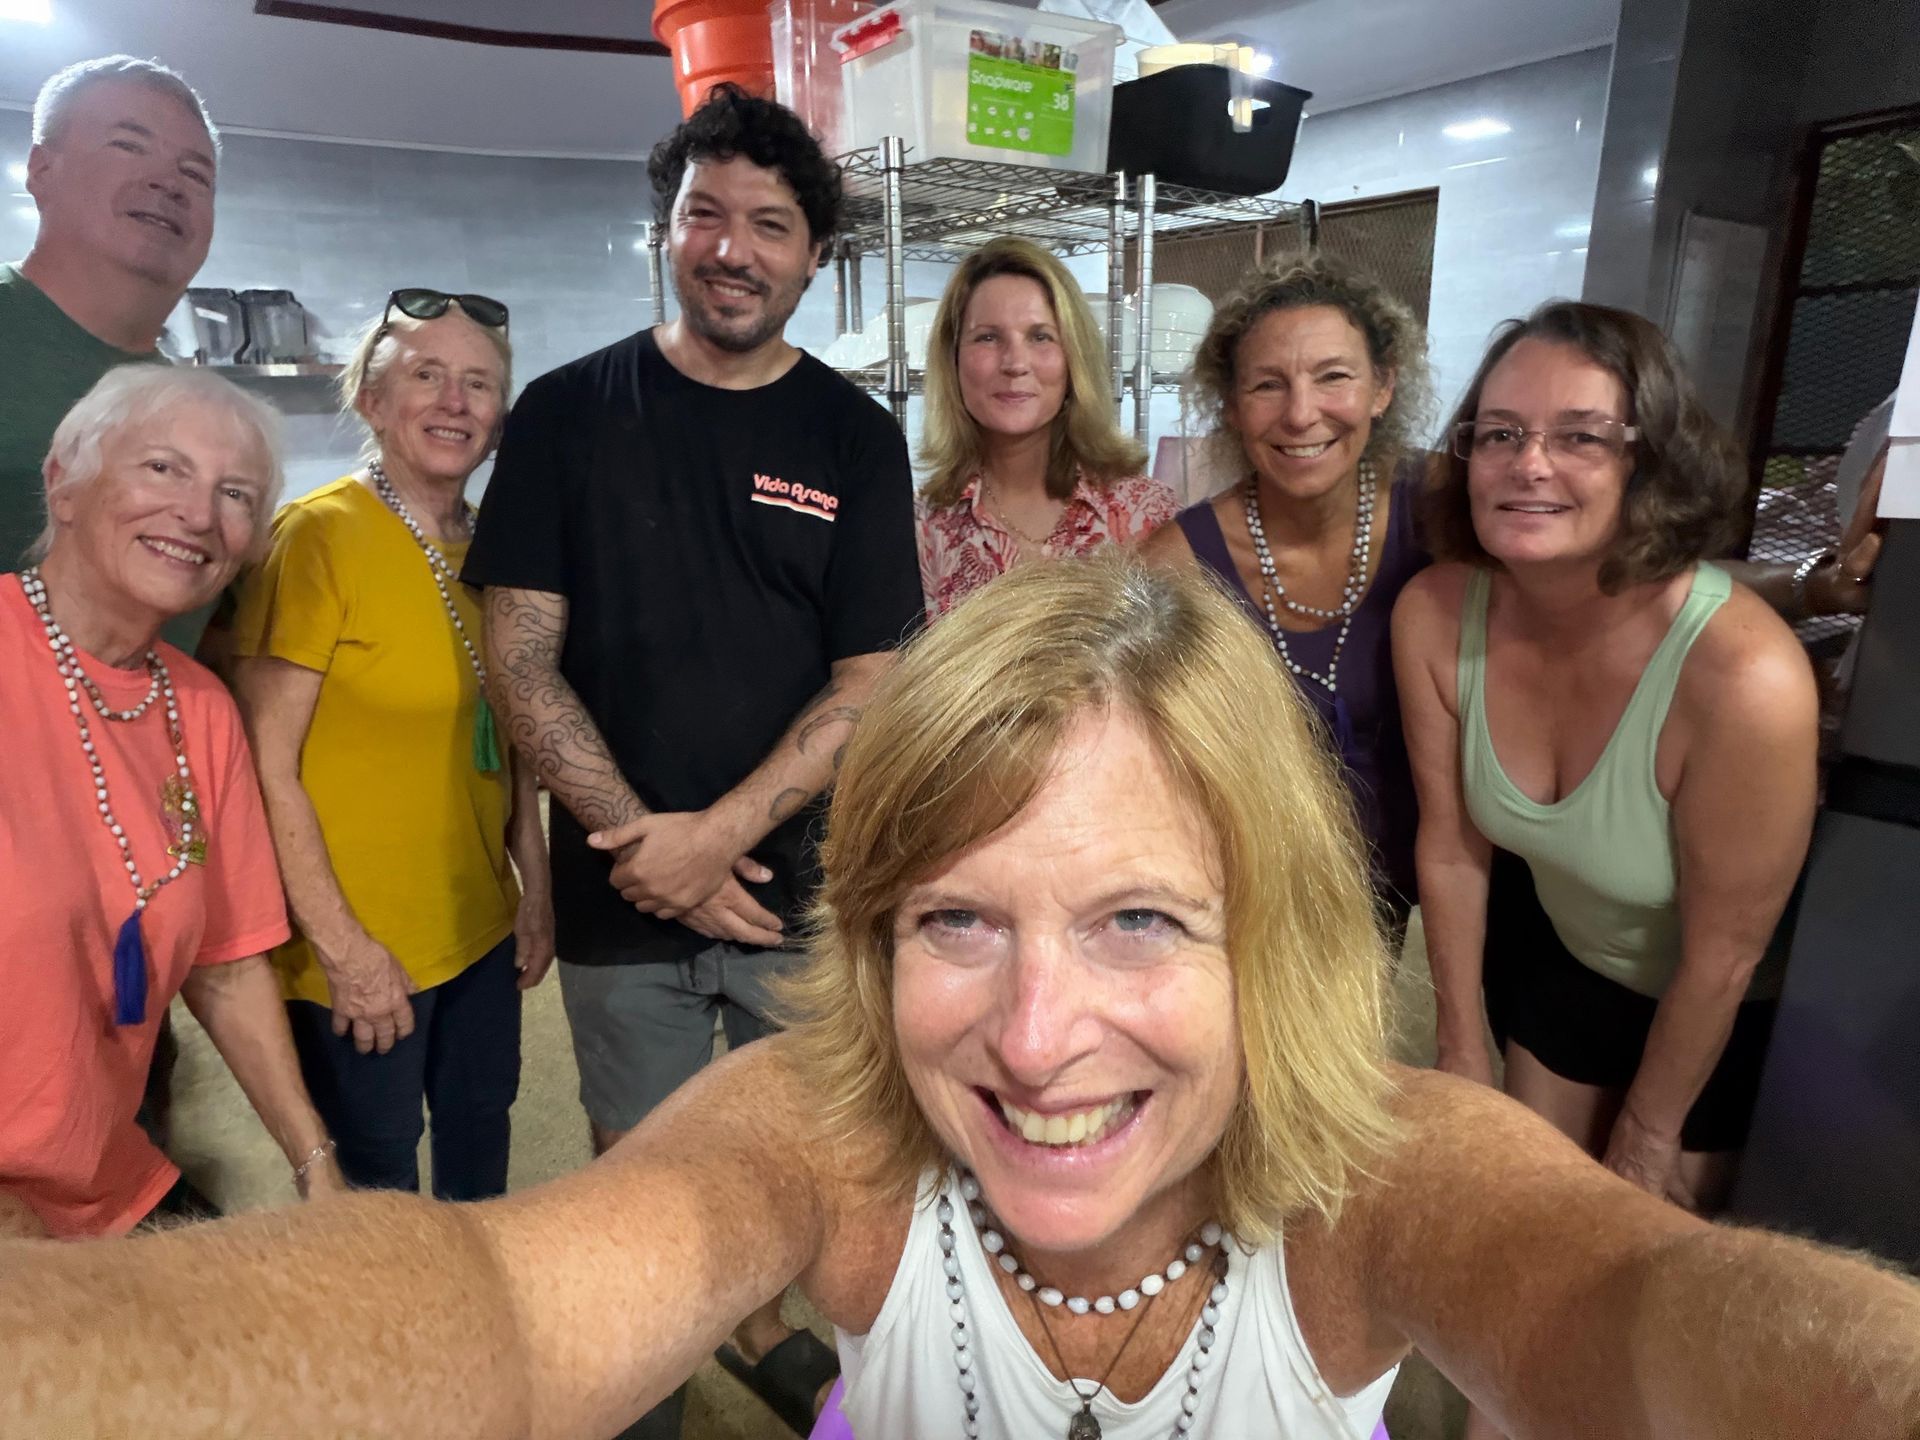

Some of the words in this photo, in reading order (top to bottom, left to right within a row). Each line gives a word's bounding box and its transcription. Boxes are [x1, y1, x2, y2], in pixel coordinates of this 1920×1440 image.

[970, 69, 1033, 93] Snapware
[1053, 92, 1070, 112] 38
[753, 473, 790, 494] Vida
